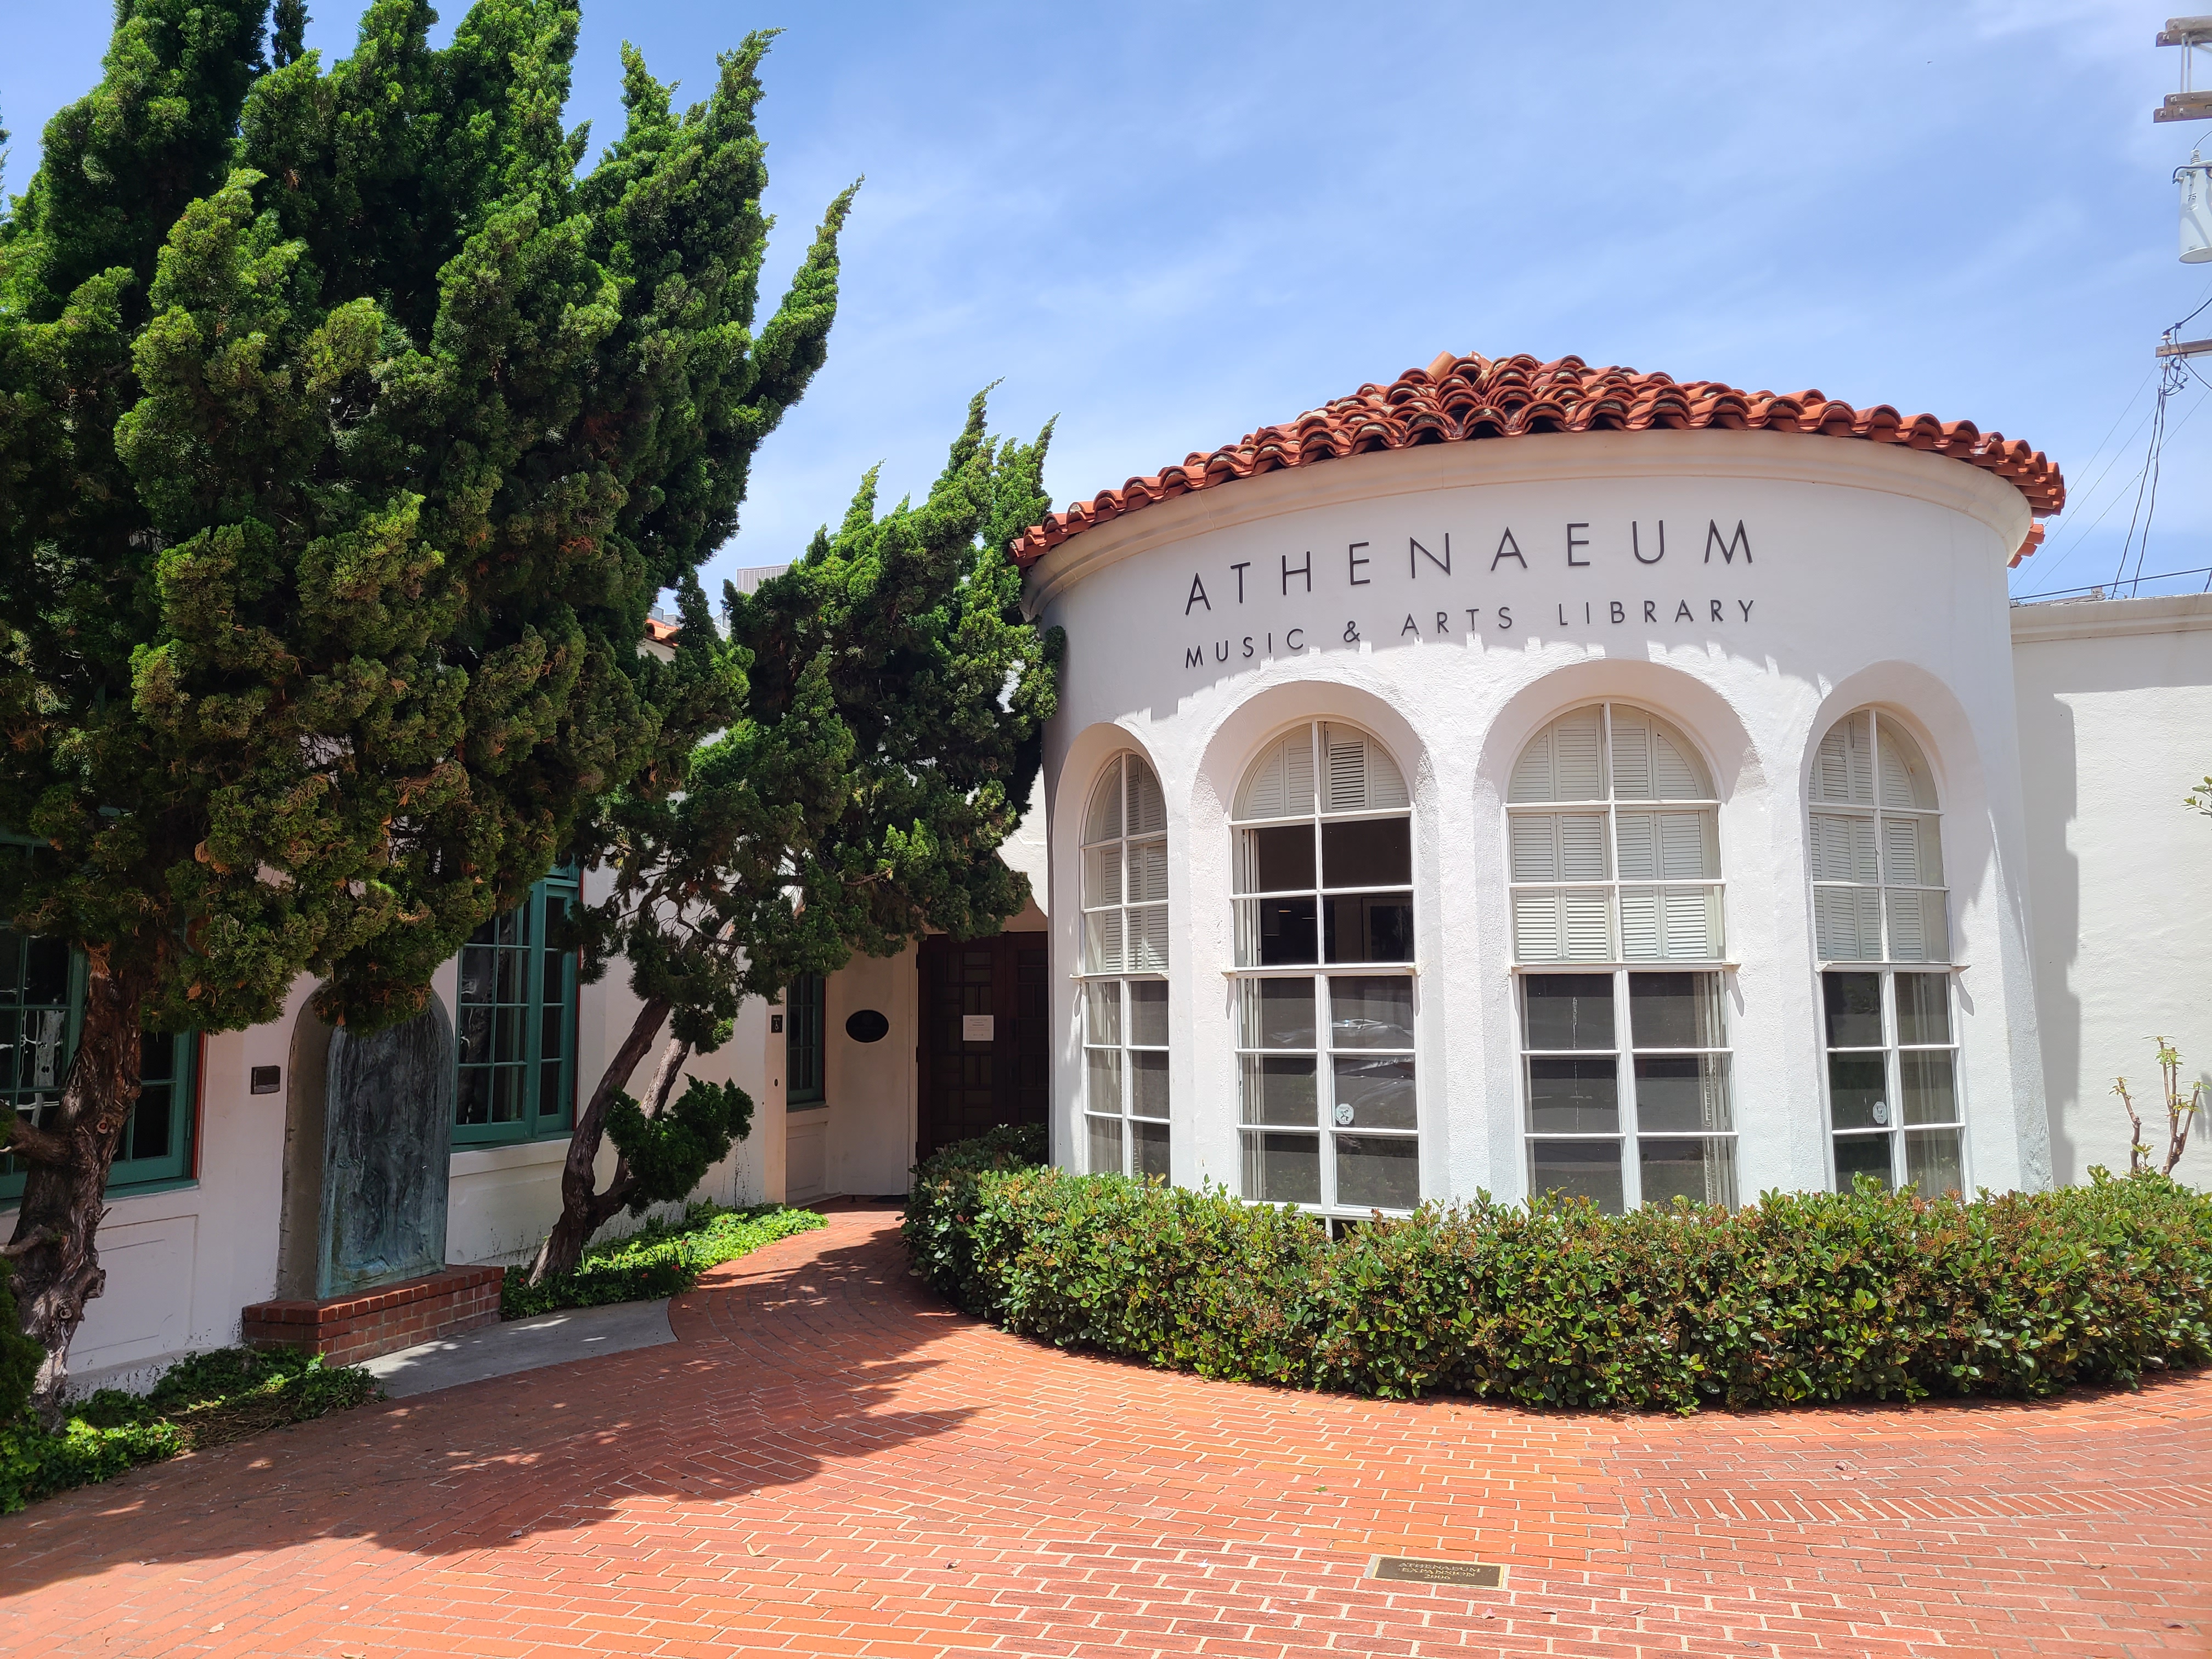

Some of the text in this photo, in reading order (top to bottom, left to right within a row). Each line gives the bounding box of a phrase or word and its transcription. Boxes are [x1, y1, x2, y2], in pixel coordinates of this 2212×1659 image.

[1185, 519, 1754, 616] ATHENAEUM
[1185, 599, 1754, 669] MUSIC & ARTS LIBRARY
[1398, 1562, 1481, 1573] ATHENAEUM
[1402, 1567, 1475, 1577] EXPANSION
